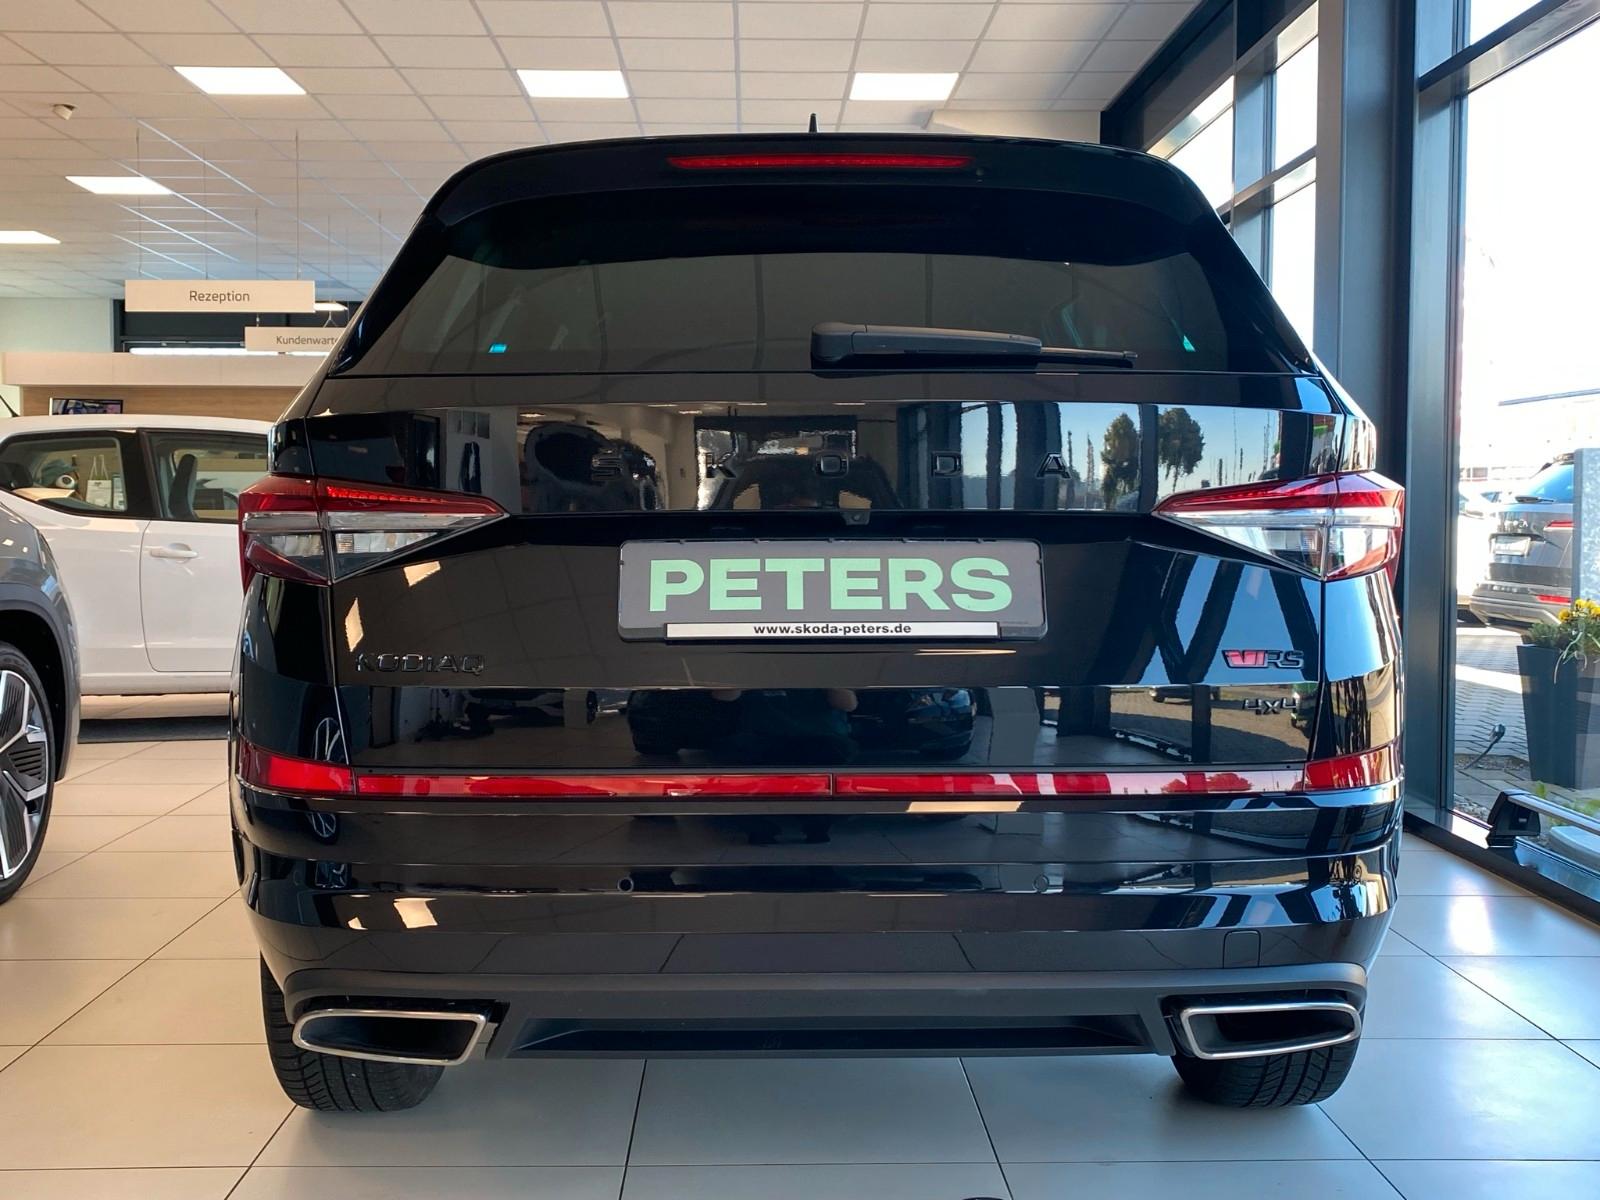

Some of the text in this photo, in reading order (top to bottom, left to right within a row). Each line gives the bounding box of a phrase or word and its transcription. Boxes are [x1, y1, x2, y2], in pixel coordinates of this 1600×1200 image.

[189, 290, 250, 304] Rezeption
[649, 557, 1013, 612] PETERS
[753, 623, 912, 636] www.skoda-peters.de
[355, 653, 485, 675] KODIAQ
